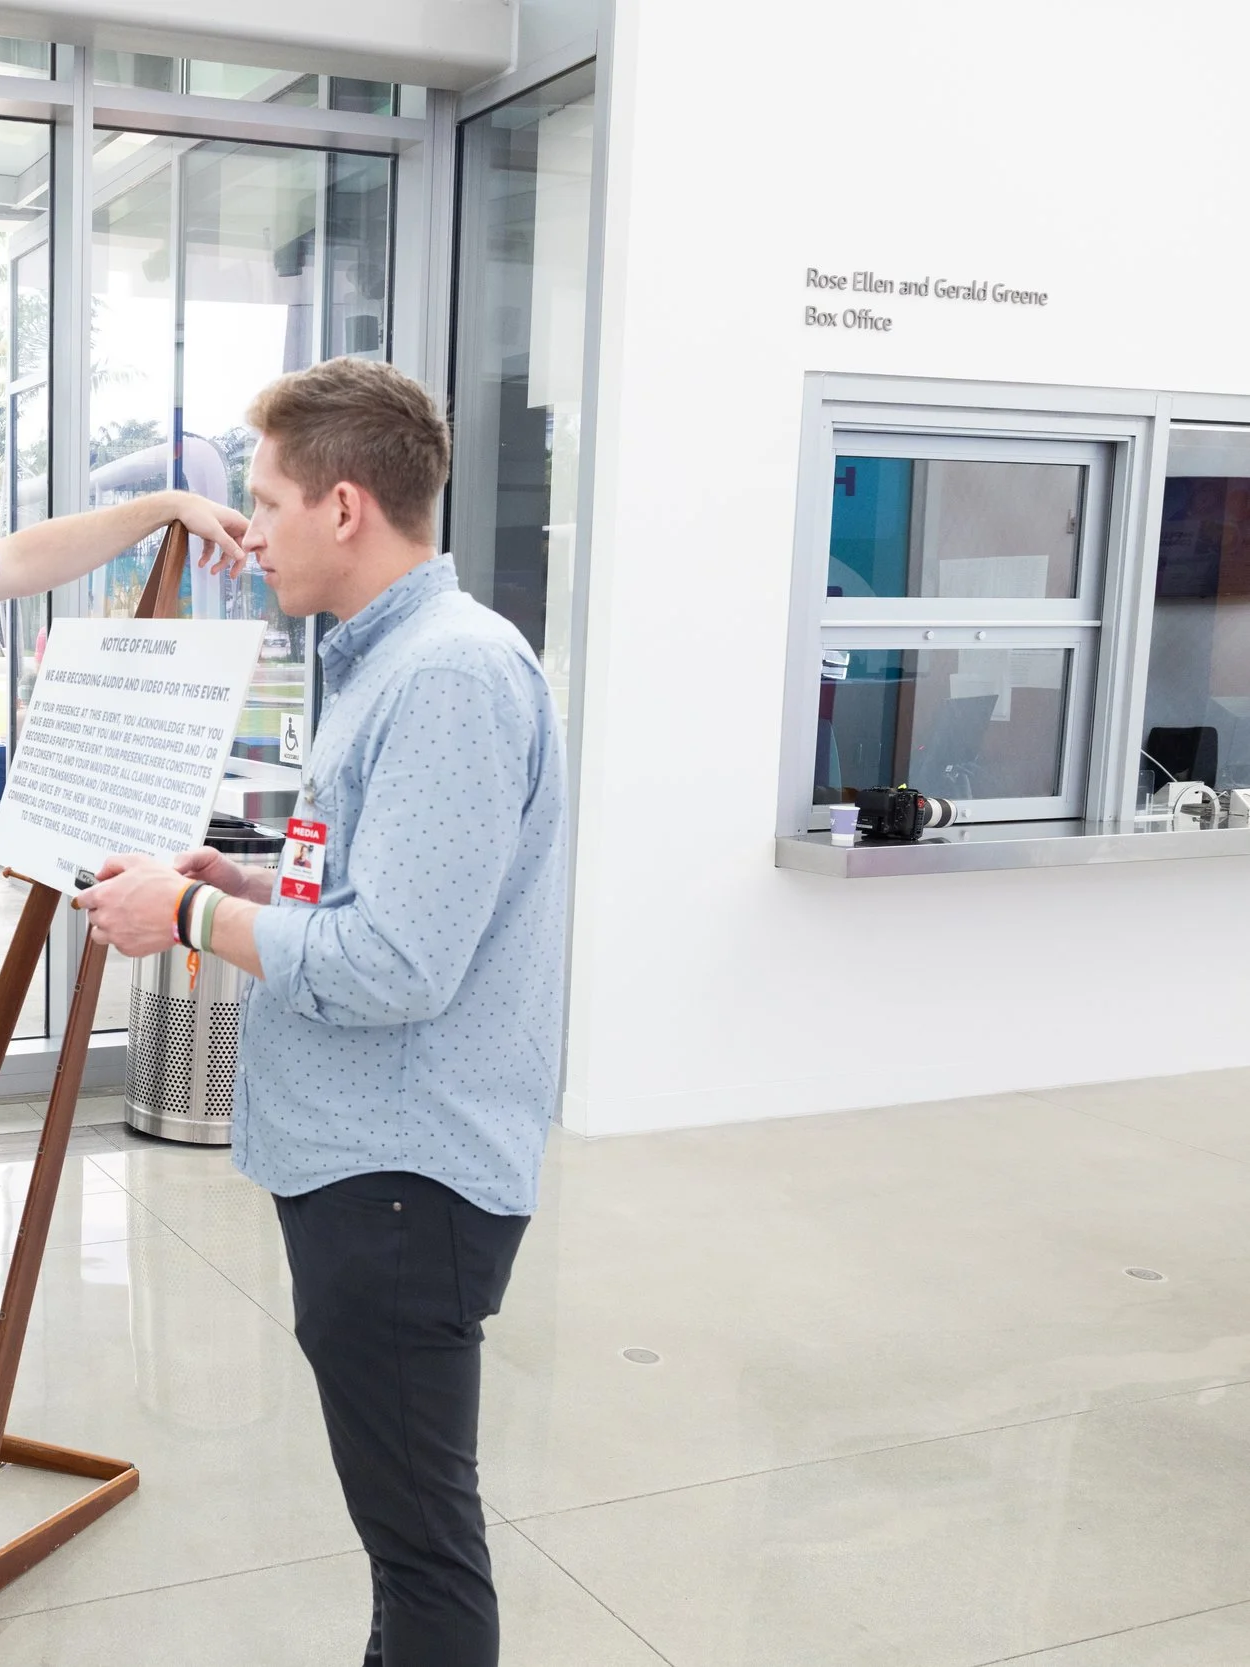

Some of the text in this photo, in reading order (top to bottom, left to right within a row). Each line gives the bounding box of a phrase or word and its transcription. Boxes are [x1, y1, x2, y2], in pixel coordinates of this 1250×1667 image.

[806, 267, 1049, 307] Rose Ellen and Gerald Greene
[804, 305, 893, 332] Box Office
[100, 637, 177, 655] NOTICE OF FILMING
[45, 669, 231, 702] WE ARE RECORDING AUDIO AND VIDEO FOR THIS EVENT.
[30, 715, 218, 760] HAVE BEEN INFORMED THAT YOU MAY BE PHOTOGRAPHED AND / OR
[34, 700, 41, 710] BY
[42, 701, 55, 713] YOUR
[55, 703, 81, 717] PRESENCE
[80, 708, 89, 718] AT
[90, 709, 102, 720] THIS
[123, 714, 137, 726] YOU
[136, 716, 186, 734] ACKNOWLEDGE
[187, 723, 206, 738] THAT
[207, 726, 224, 741] YOU
[22, 745, 34, 756] YOUR
[33, 748, 56, 761] CONSENT
[63, 754, 75, 766] AND
[75, 757, 91, 769] YOUR
[90, 760, 111, 775] WAIVER
[120, 767, 131, 780] ALL
[131, 770, 155, 786] CLAIMS
[154, 774, 163, 787] IN
[162, 776, 207, 798] CONNECTION
[25, 730, 50, 744] RECORDED
[55, 736, 69, 748] PART
[67, 739, 76, 749] OF
[75, 740, 86, 752] THE
[104, 747, 120, 758] YOUR
[119, 749, 150, 766] PRESENCE
[149, 755, 167, 770] HERE
[165, 758, 213, 779] CONSTITUTES
[12, 775, 28, 787] IMAGE
[27, 779, 39, 790] AND
[38, 782, 54, 795] VOICE
[53, 786, 62, 796] BY
[61, 788, 73, 801] THE
[72, 791, 87, 804] NEW
[86, 795, 108, 811] WORLD
[108, 801, 144, 820] SYMPHONY
[145, 811, 158, 825] FOR
[17, 759, 30, 770] WITH
[29, 762, 38, 772] THE
[37, 765, 50, 777] LIVE
[49, 767, 86, 787] TRANSMISSION
[85, 778, 97, 790] AND
[100, 780, 110, 792] OR
[109, 783, 143, 802] RECORDING
[142, 792, 158, 806] AND
[157, 795, 171, 809] USE
[170, 798, 181, 811] OF
[180, 801, 201, 817] YOUR
[8, 788, 39, 808] COMMERCIAL
[37, 798, 46, 809] OR
[44, 800, 62, 814] OTHER
[90, 814, 97, 825] IF
[97, 816, 110, 830] YOU
[109, 820, 122, 834] ARE
[121, 824, 156, 845] UNWILLING
[156, 834, 166, 848] TO
[21, 809, 29, 820] TO
[29, 811, 43, 826] THESE
[60, 823, 81, 839] PLEASE
[80, 829, 107, 847] CONTACT
[105, 837, 119, 852] THE
[292, 826, 320, 839] MEDIA
